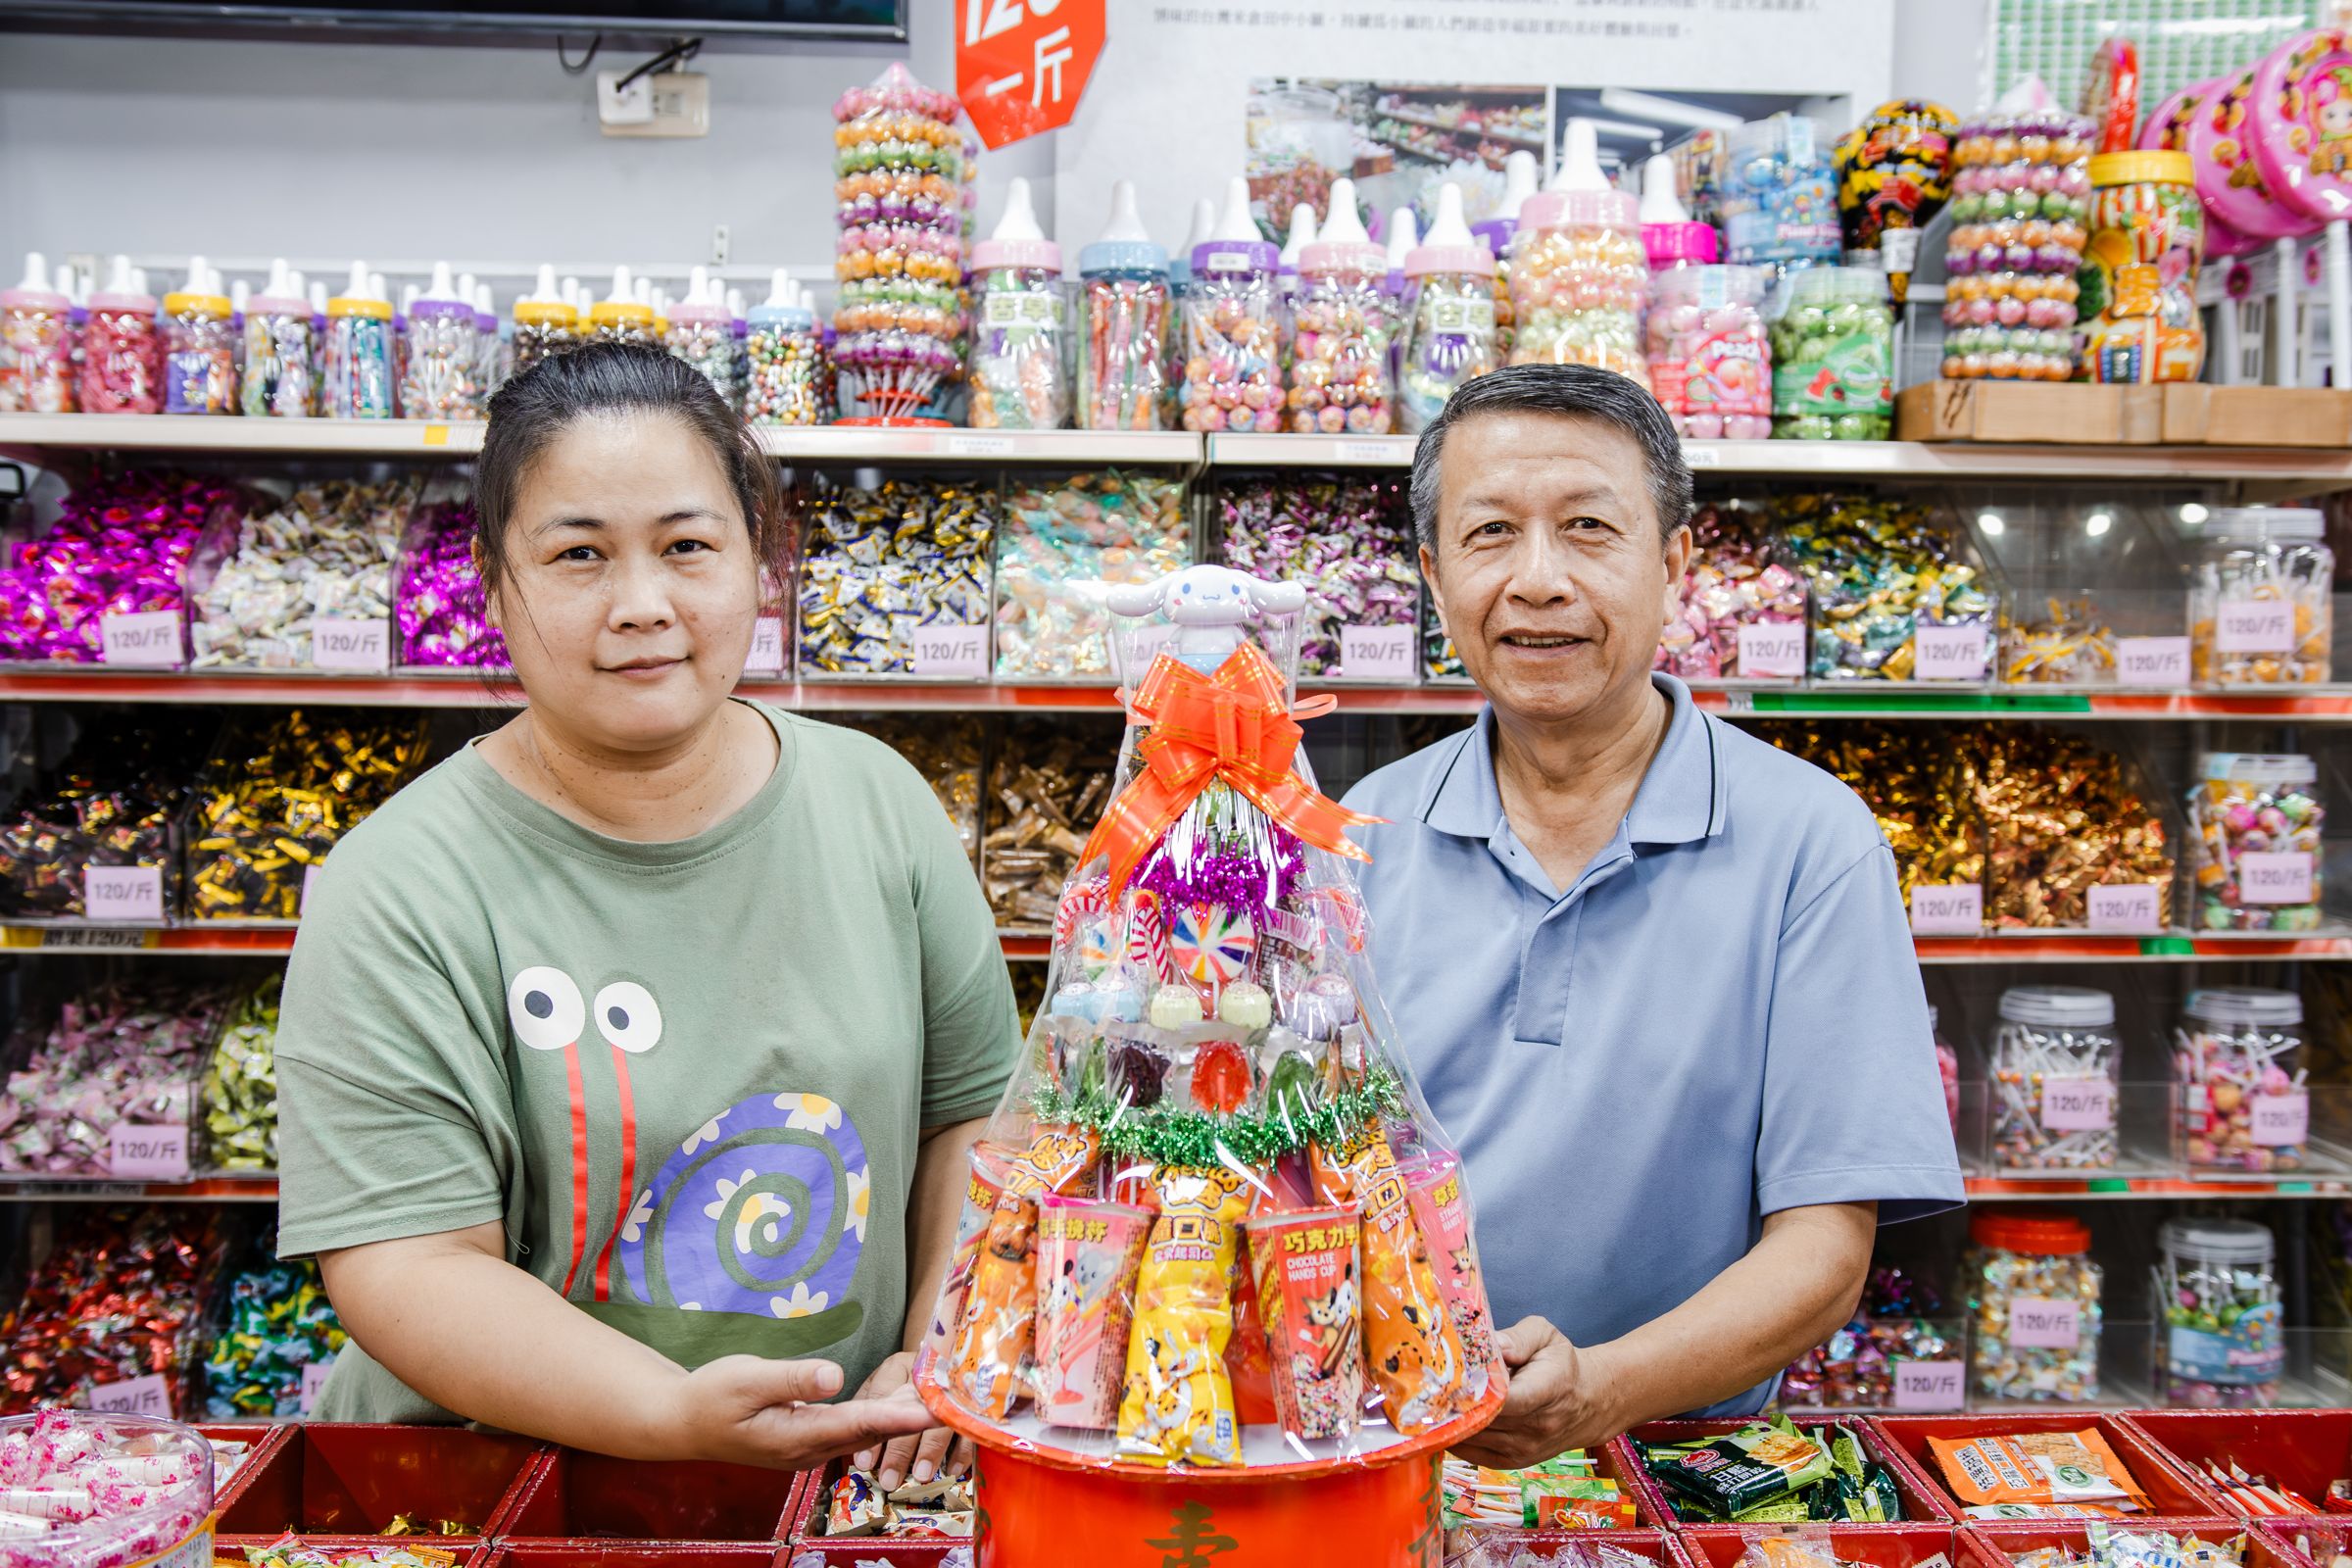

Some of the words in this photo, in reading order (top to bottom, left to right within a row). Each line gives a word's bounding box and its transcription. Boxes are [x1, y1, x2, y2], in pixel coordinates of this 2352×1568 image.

[965, 0, 1061, 46] 12
[985, 25, 1072, 108] 一斤
[2226, 616, 2285, 635] 120/斤
[112, 628, 171, 652] 120/斤
[320, 633, 380, 654] 120/斤
[1747, 640, 1802, 659] 120/斤
[920, 641, 980, 662] 120/斤
[1348, 641, 1408, 662] 120/斤
[1922, 642, 1978, 662] 120/斤
[2126, 653, 2181, 673] 120/斤
[2250, 868, 2305, 887] 120/斤
[94, 882, 154, 901] 120/斤
[1919, 898, 1973, 918] 120/斤
[2096, 899, 2150, 918] 120/斤
[2051, 1095, 2106, 1113] 120/斤
[120, 1140, 178, 1160] 120/斤
[1286, 1251, 1337, 1270] CHOCOLATE
[1288, 1267, 1317, 1283] HANDS
[1320, 1264, 1337, 1278] CUP
[2017, 1313, 2073, 1332] 120/斤
[1903, 1375, 1957, 1394] 120/斤
